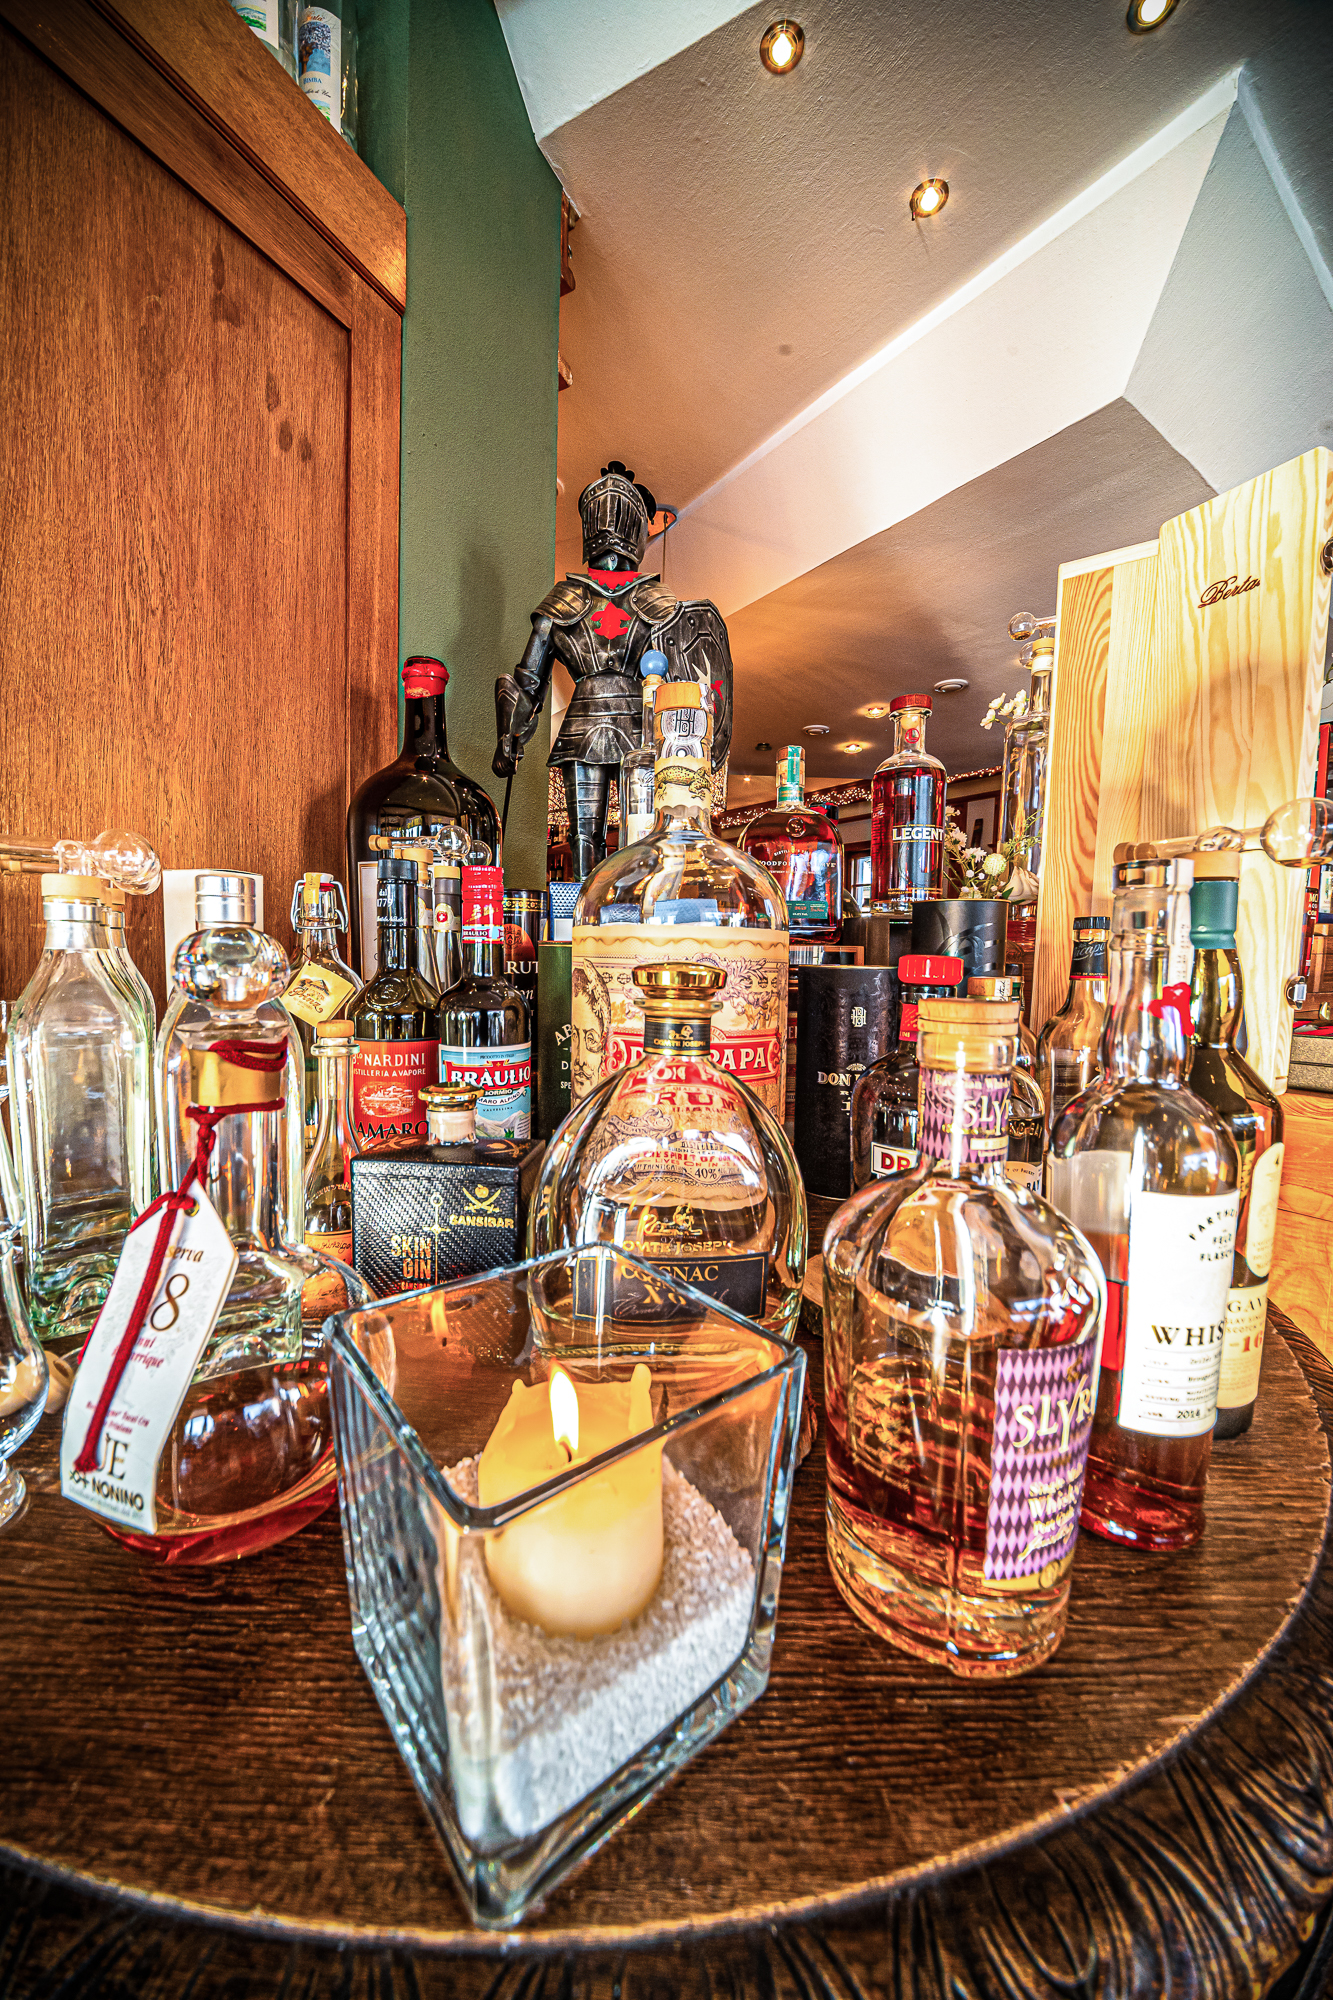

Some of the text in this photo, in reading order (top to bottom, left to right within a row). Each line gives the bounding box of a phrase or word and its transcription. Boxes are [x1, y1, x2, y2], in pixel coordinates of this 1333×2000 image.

[892, 828, 944, 841] LEGENT
[364, 1052, 426, 1067] NARDINI
[353, 1068, 390, 1077] ISTILLERIA
[398, 1068, 427, 1077] VAPORE
[817, 1071, 851, 1087] DON
[477, 1095, 499, 1105] MARO
[356, 1121, 430, 1140] AMARO
[694, 1168, 718, 1181] 40%
[449, 1214, 515, 1229] SANSIBAR
[165, 1246, 204, 1263] serva
[391, 1234, 432, 1259] SKIN
[620, 1240, 671, 1253] OMTE
[402, 1257, 432, 1280] GIN
[149, 1273, 190, 1332] 8
[1151, 1320, 1225, 1347] WHIS
[1242, 1330, 1264, 1353] 16
[1012, 1373, 1095, 1453] SLYR
[91, 1476, 145, 1513] NONINO
